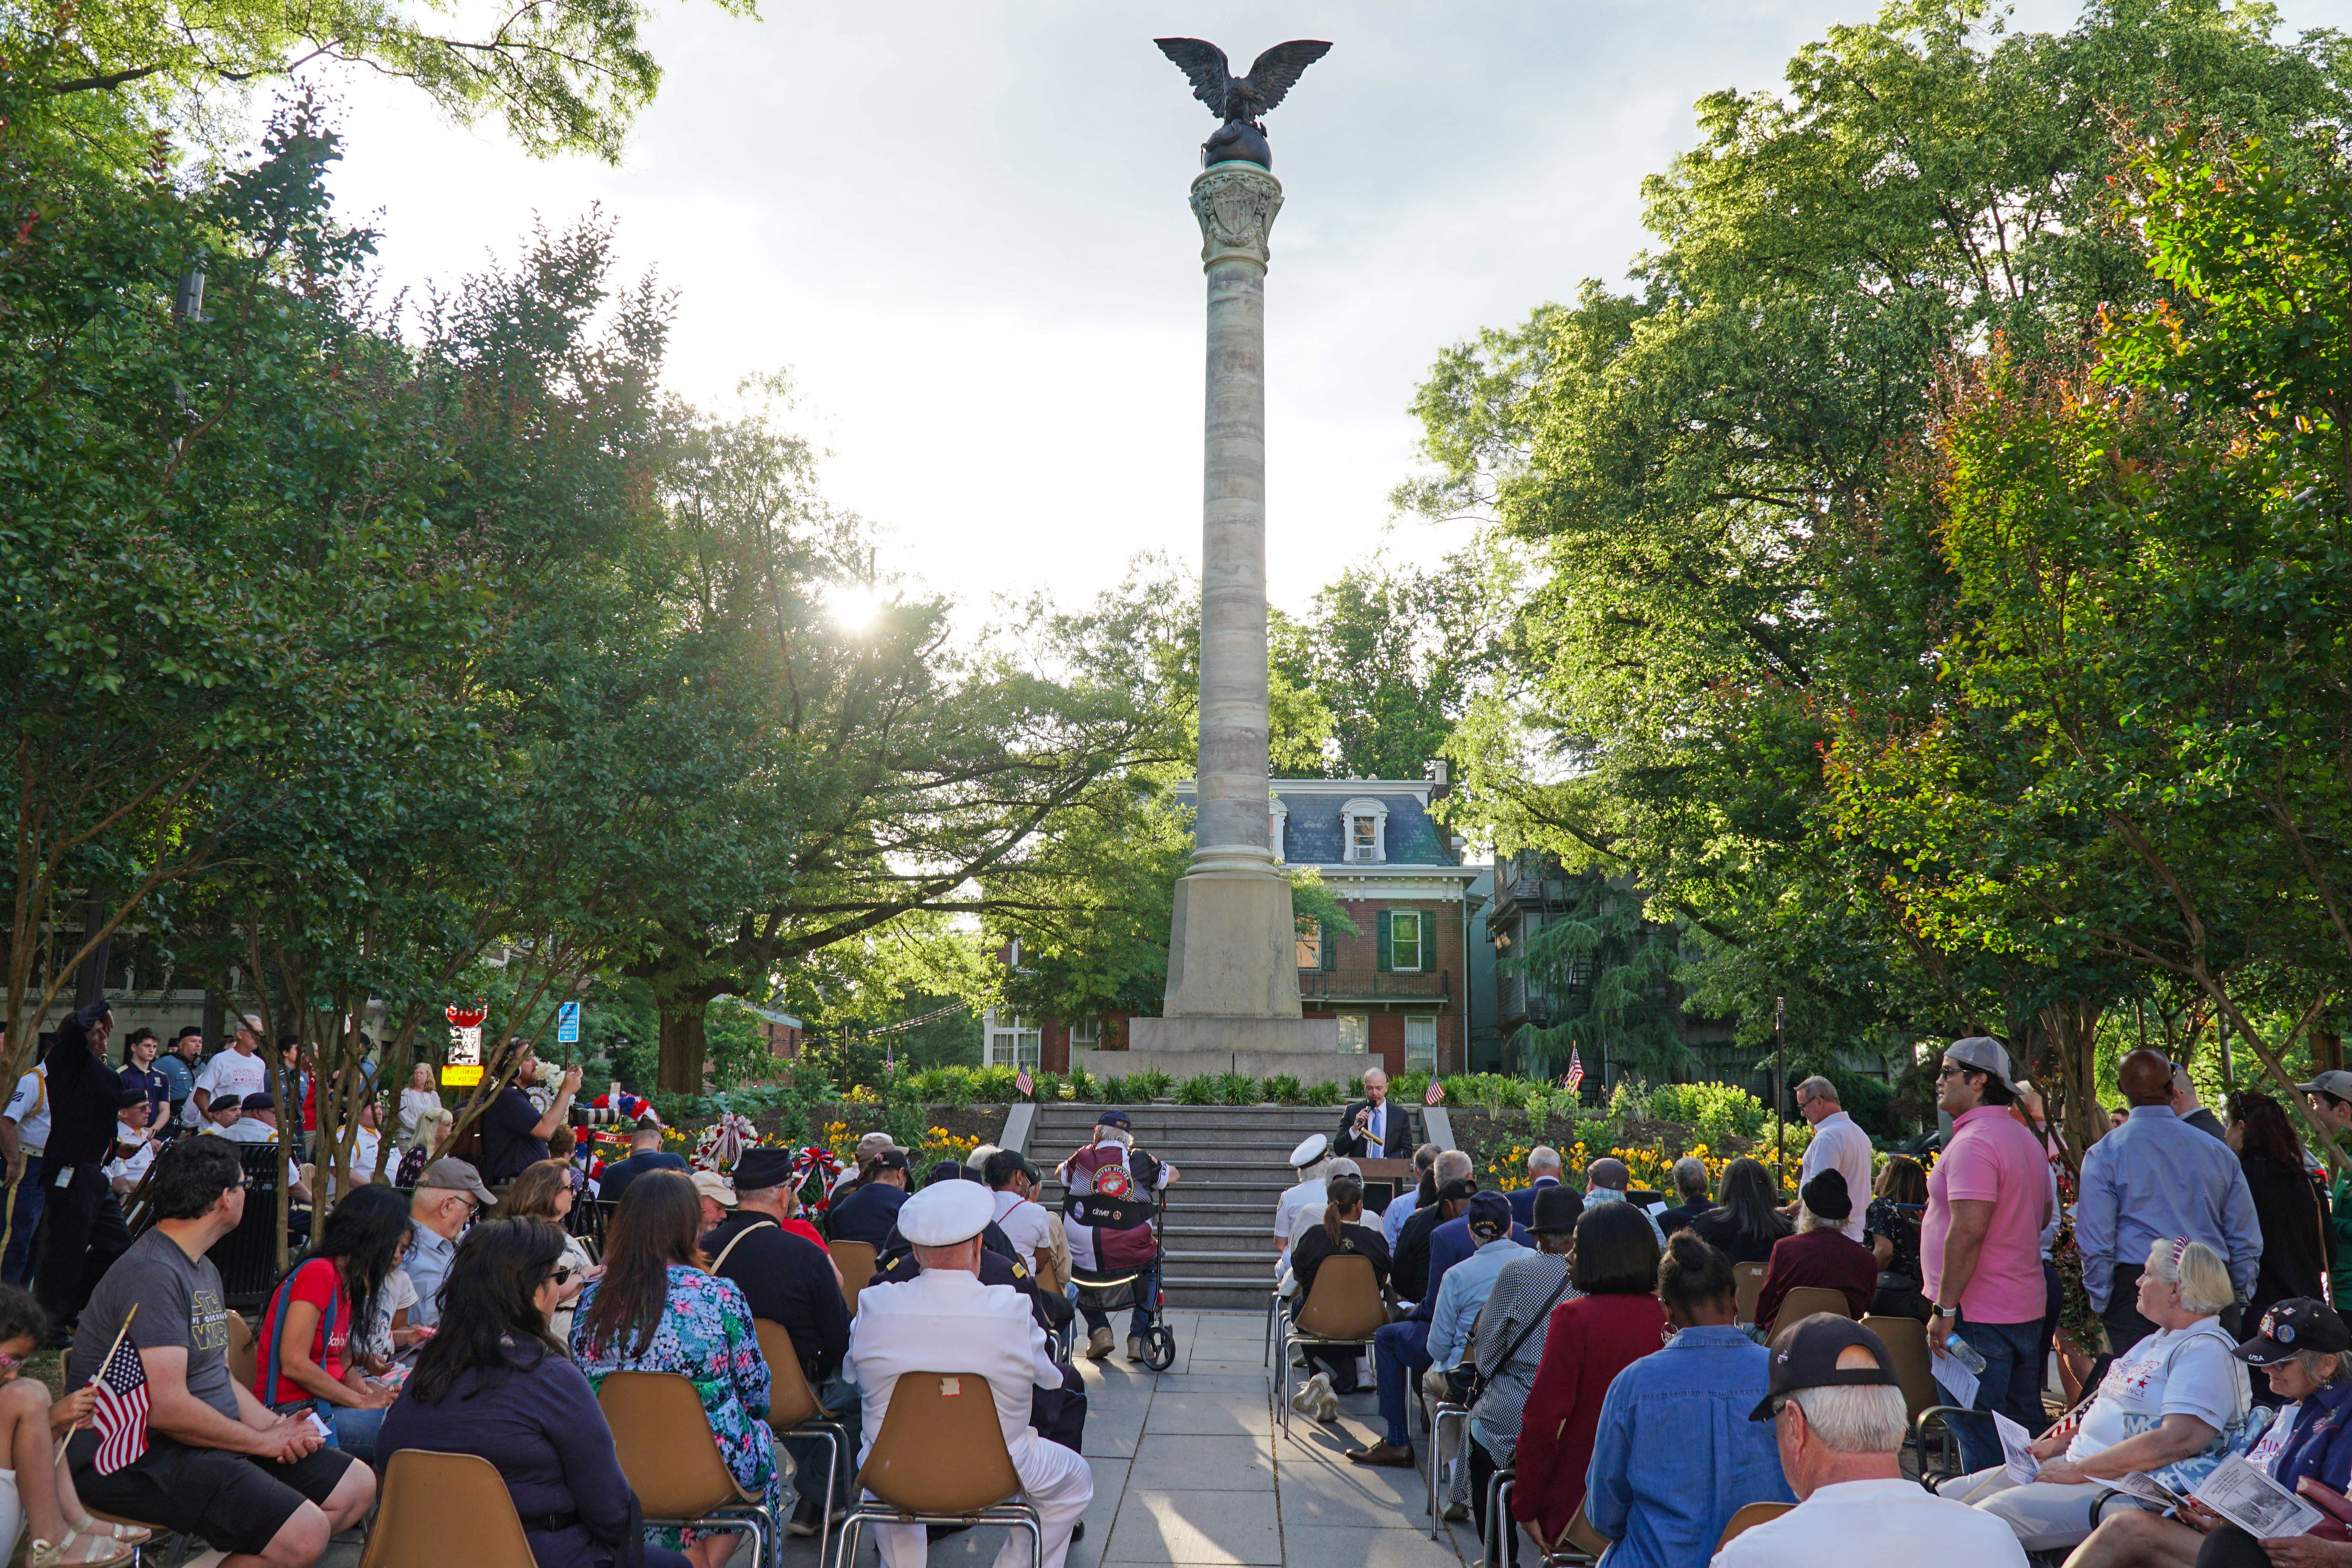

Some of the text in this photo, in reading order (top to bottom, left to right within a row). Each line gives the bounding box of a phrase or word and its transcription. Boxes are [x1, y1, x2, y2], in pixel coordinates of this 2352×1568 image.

[1094, 1167, 1130, 1181] UNITED STATES
[1118, 1187, 1131, 1200] CORPS
[1092, 1207, 1110, 1217] drive
[2110, 1382, 2145, 1397] OBSERVANCE
